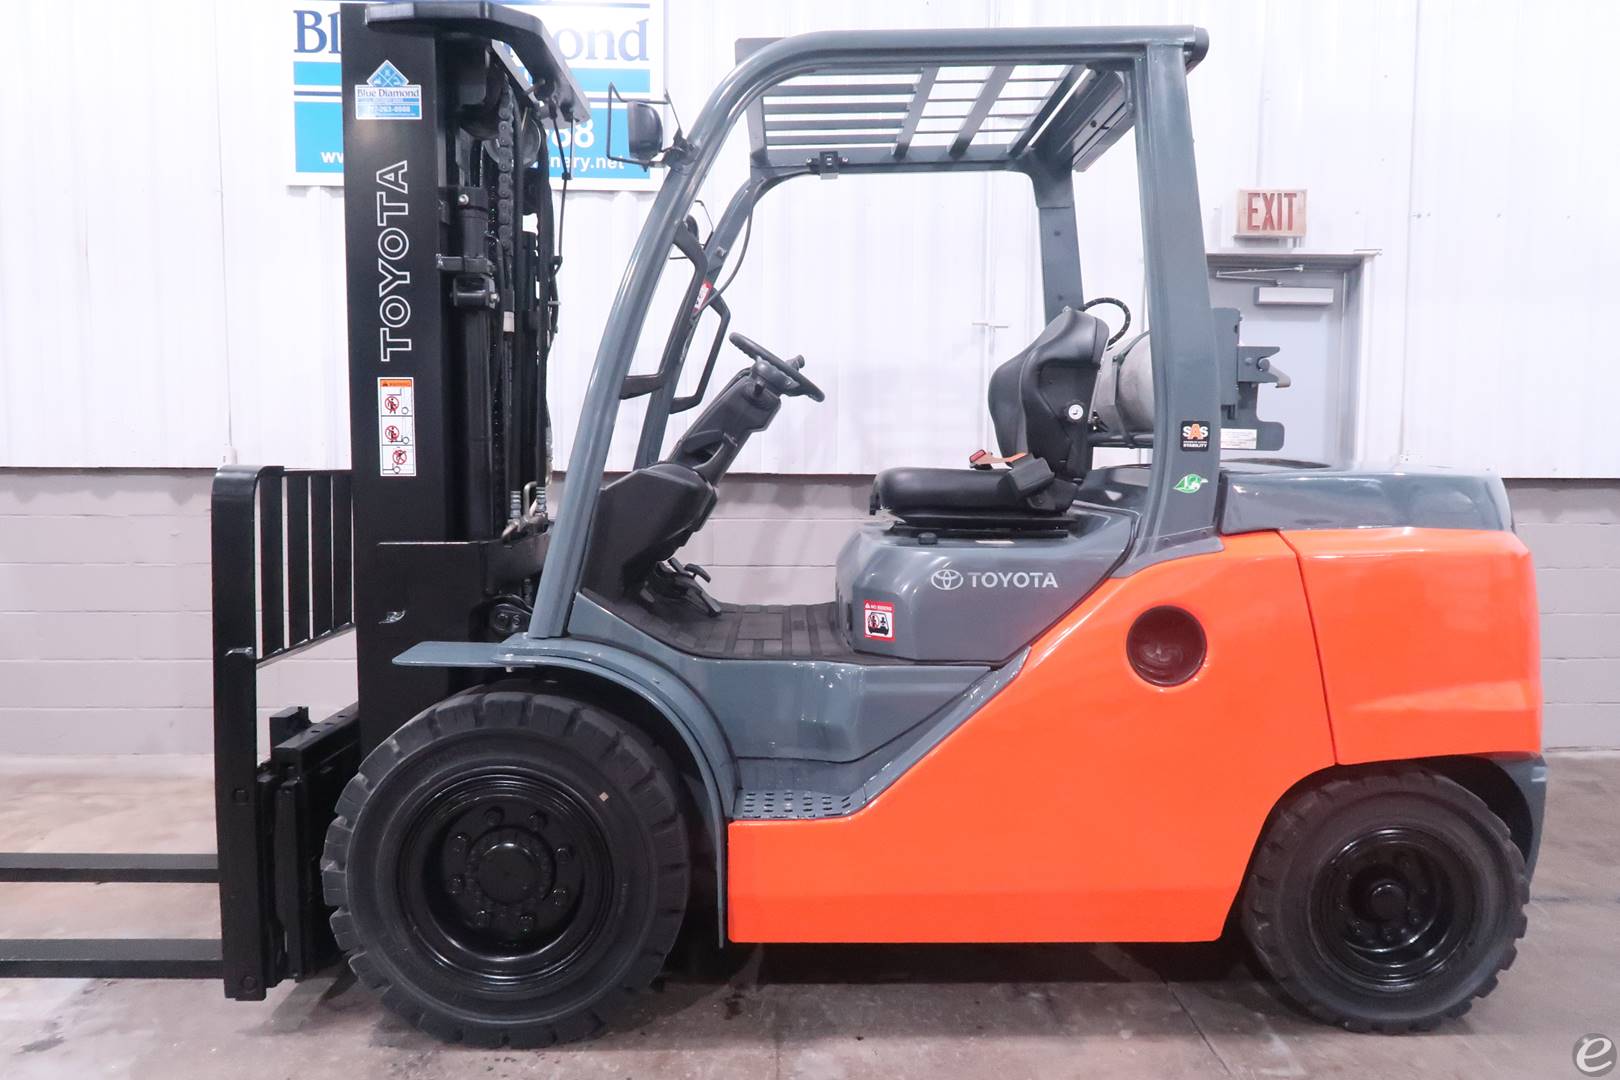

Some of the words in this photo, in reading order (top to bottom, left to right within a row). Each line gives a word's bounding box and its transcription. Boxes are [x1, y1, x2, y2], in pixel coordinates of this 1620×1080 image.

[293, 10, 341, 54] Bl
[357, 89, 377, 97] Blue
[378, 89, 419, 97] Diamond
[1247, 192, 1297, 231] EXIT
[376, 160, 412, 362] TOYOTA
[1182, 423, 1209, 440] SAS
[968, 572, 1059, 588] TOYOTA
